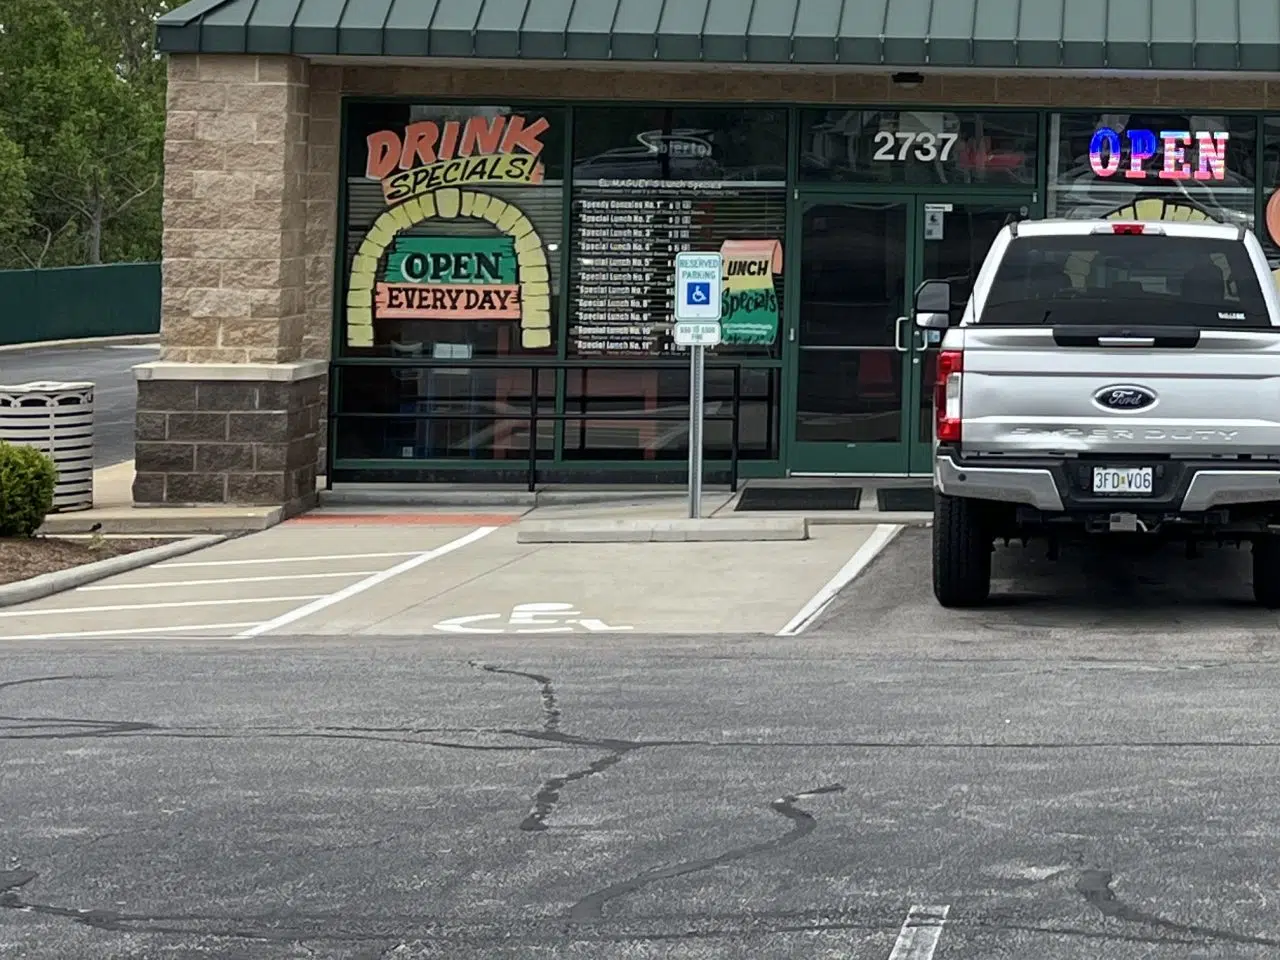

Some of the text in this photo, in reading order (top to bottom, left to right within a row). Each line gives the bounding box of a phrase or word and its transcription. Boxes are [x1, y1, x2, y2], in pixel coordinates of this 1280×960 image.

[366, 115, 549, 180] DRINK
[873, 131, 958, 161] 2737
[1089, 127, 1229, 179] OPEN
[387, 157, 539, 201] SPECIALS!
[401, 251, 504, 283] OPEN
[680, 259, 718, 268] RESERVED
[682, 271, 716, 279] PARKING
[387, 287, 512, 310] EVERYDAY
[1108, 390, 1142, 405] Ford
